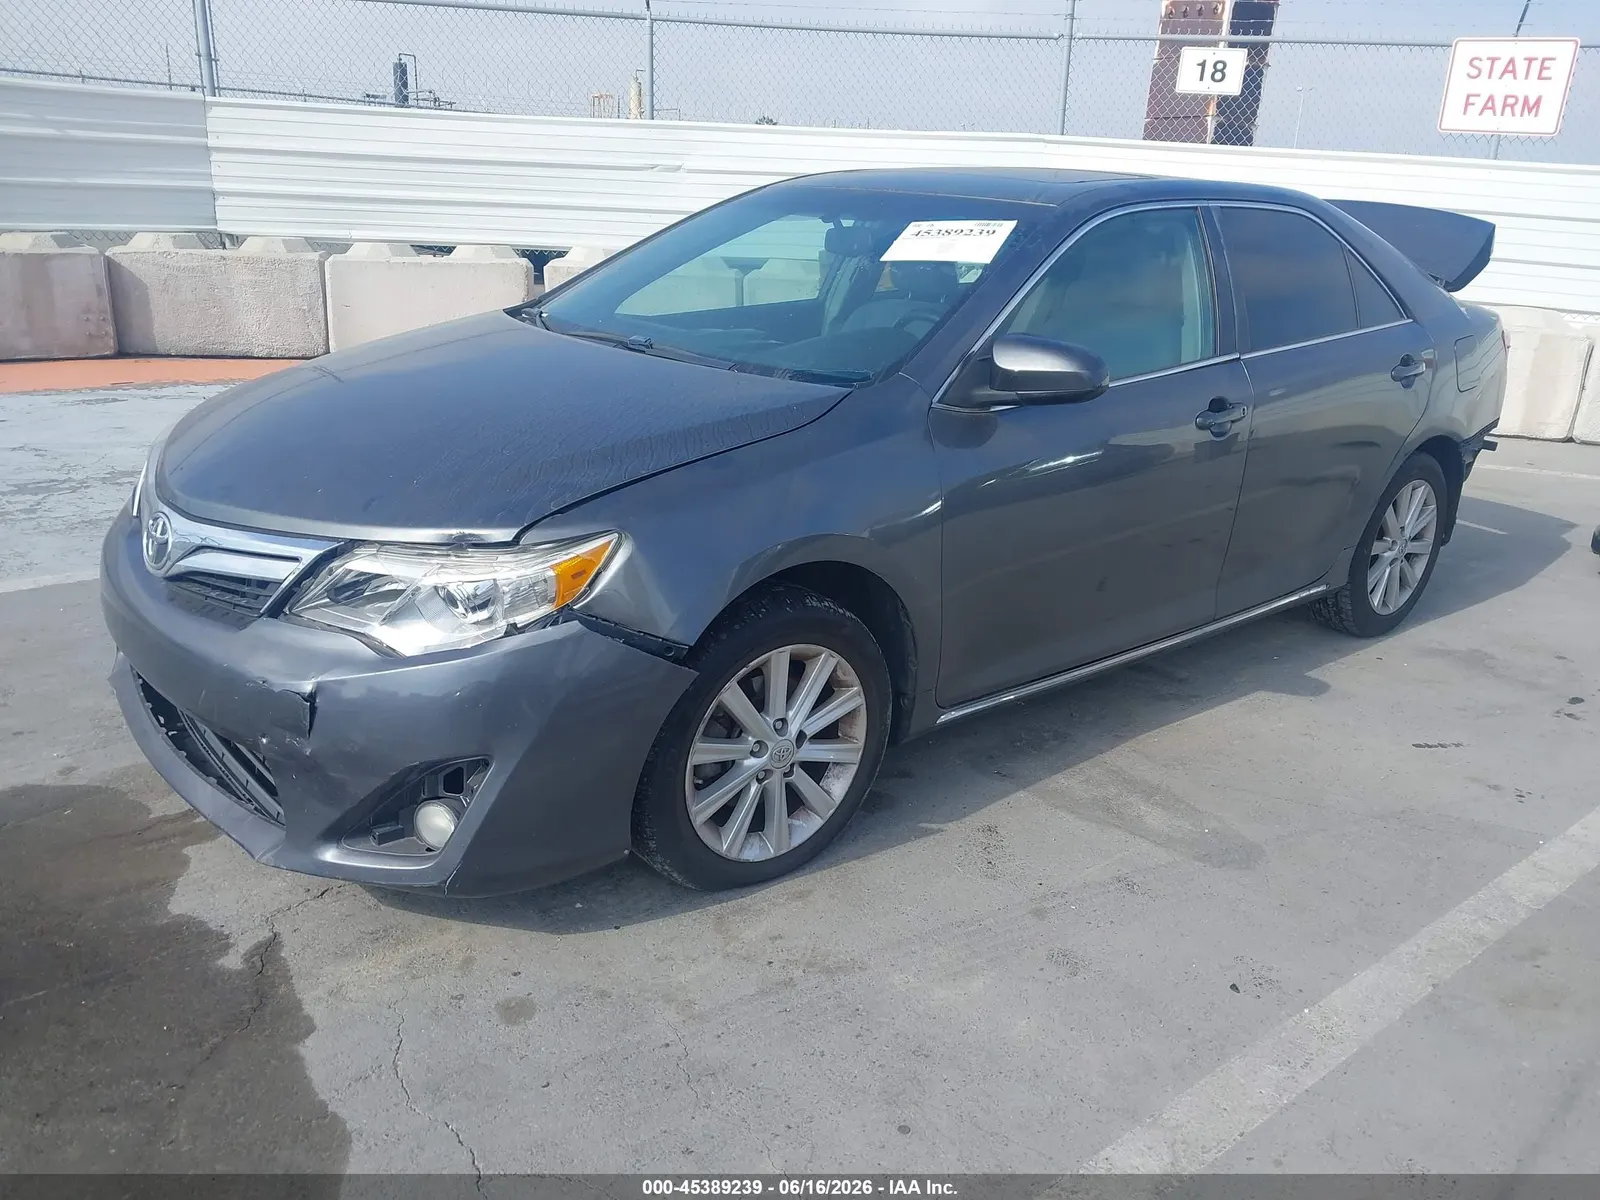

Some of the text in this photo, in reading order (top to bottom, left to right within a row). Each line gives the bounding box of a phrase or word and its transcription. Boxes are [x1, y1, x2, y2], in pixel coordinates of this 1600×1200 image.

[1196, 59, 1228, 83] 18
[1466, 56, 1557, 81] STATE
[1463, 94, 1543, 118] FARM
[911, 228, 996, 237] 45389239
